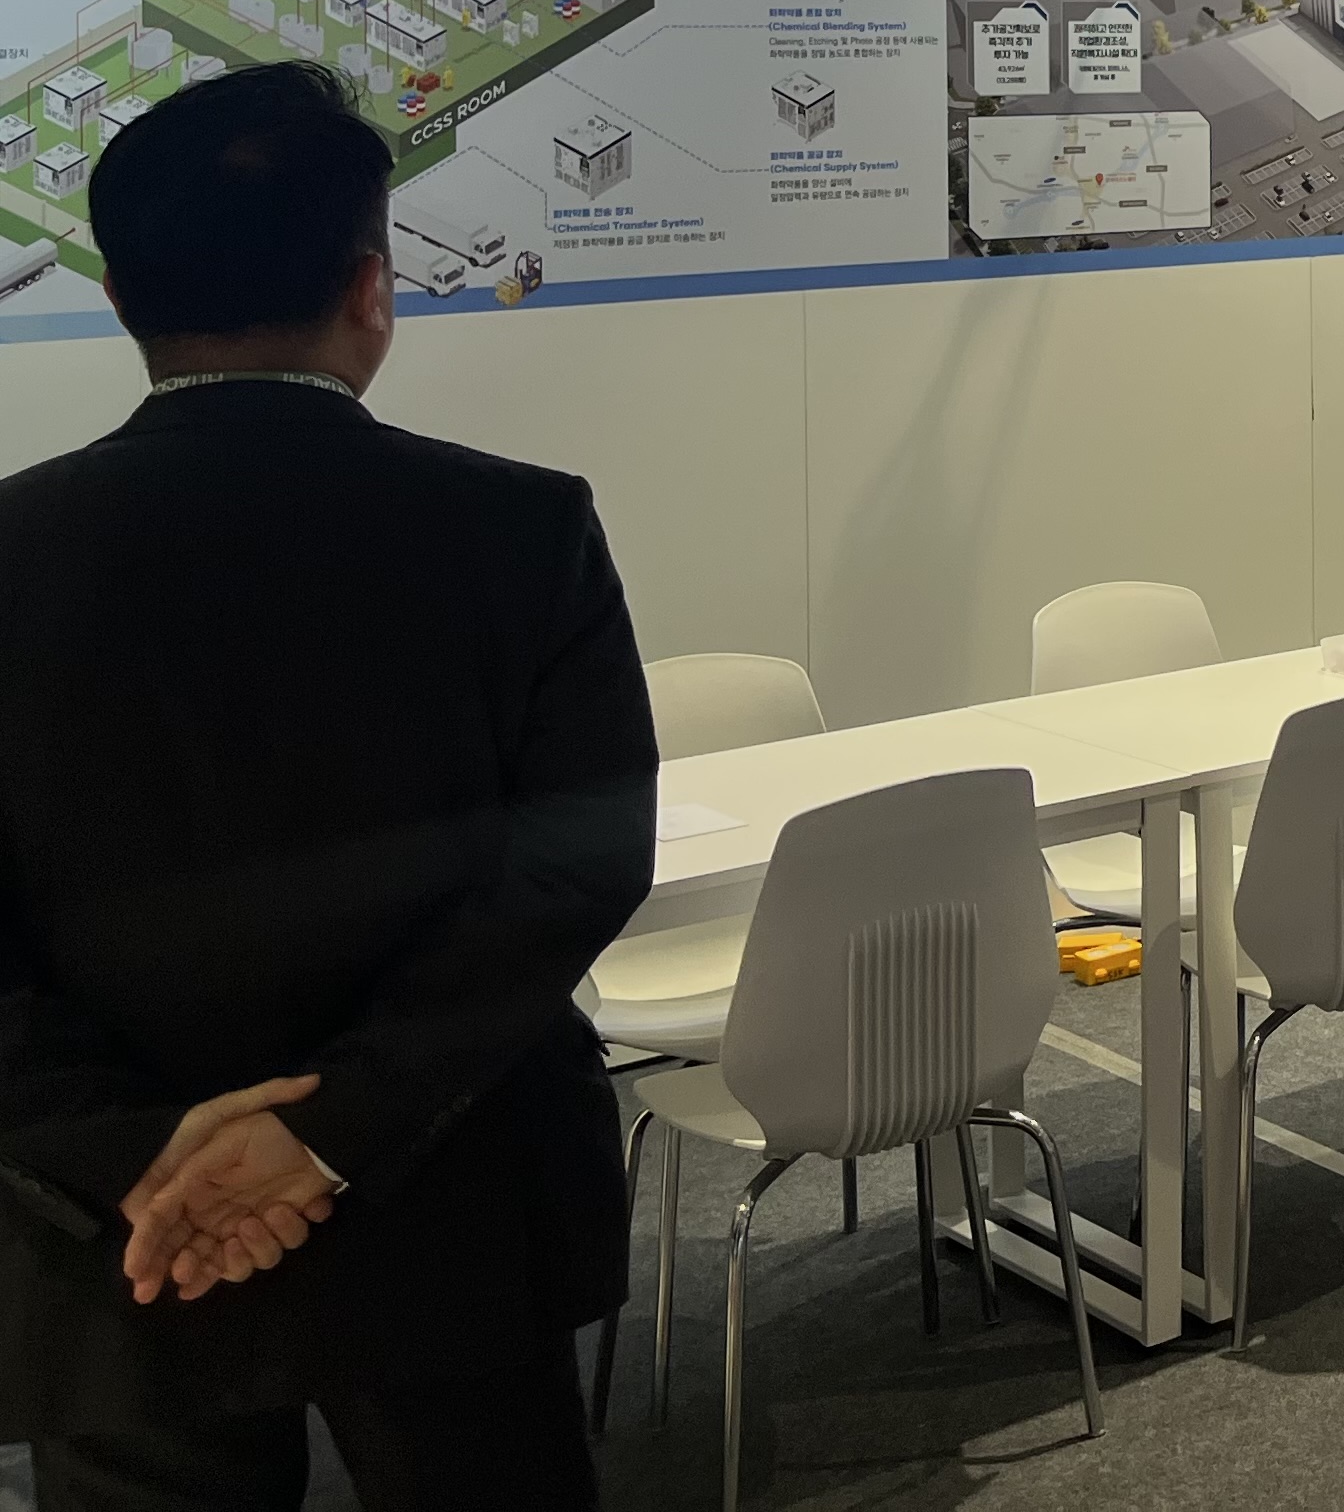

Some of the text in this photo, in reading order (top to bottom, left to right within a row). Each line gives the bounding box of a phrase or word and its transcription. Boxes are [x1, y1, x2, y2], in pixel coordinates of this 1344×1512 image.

[768, 22, 907, 33] (Chemical Blending System)
[411, 80, 507, 146] CCSS ROOM
[769, 160, 899, 175] (Chemical Supply System)
[552, 216, 705, 234] (Chemical Transfer System)
